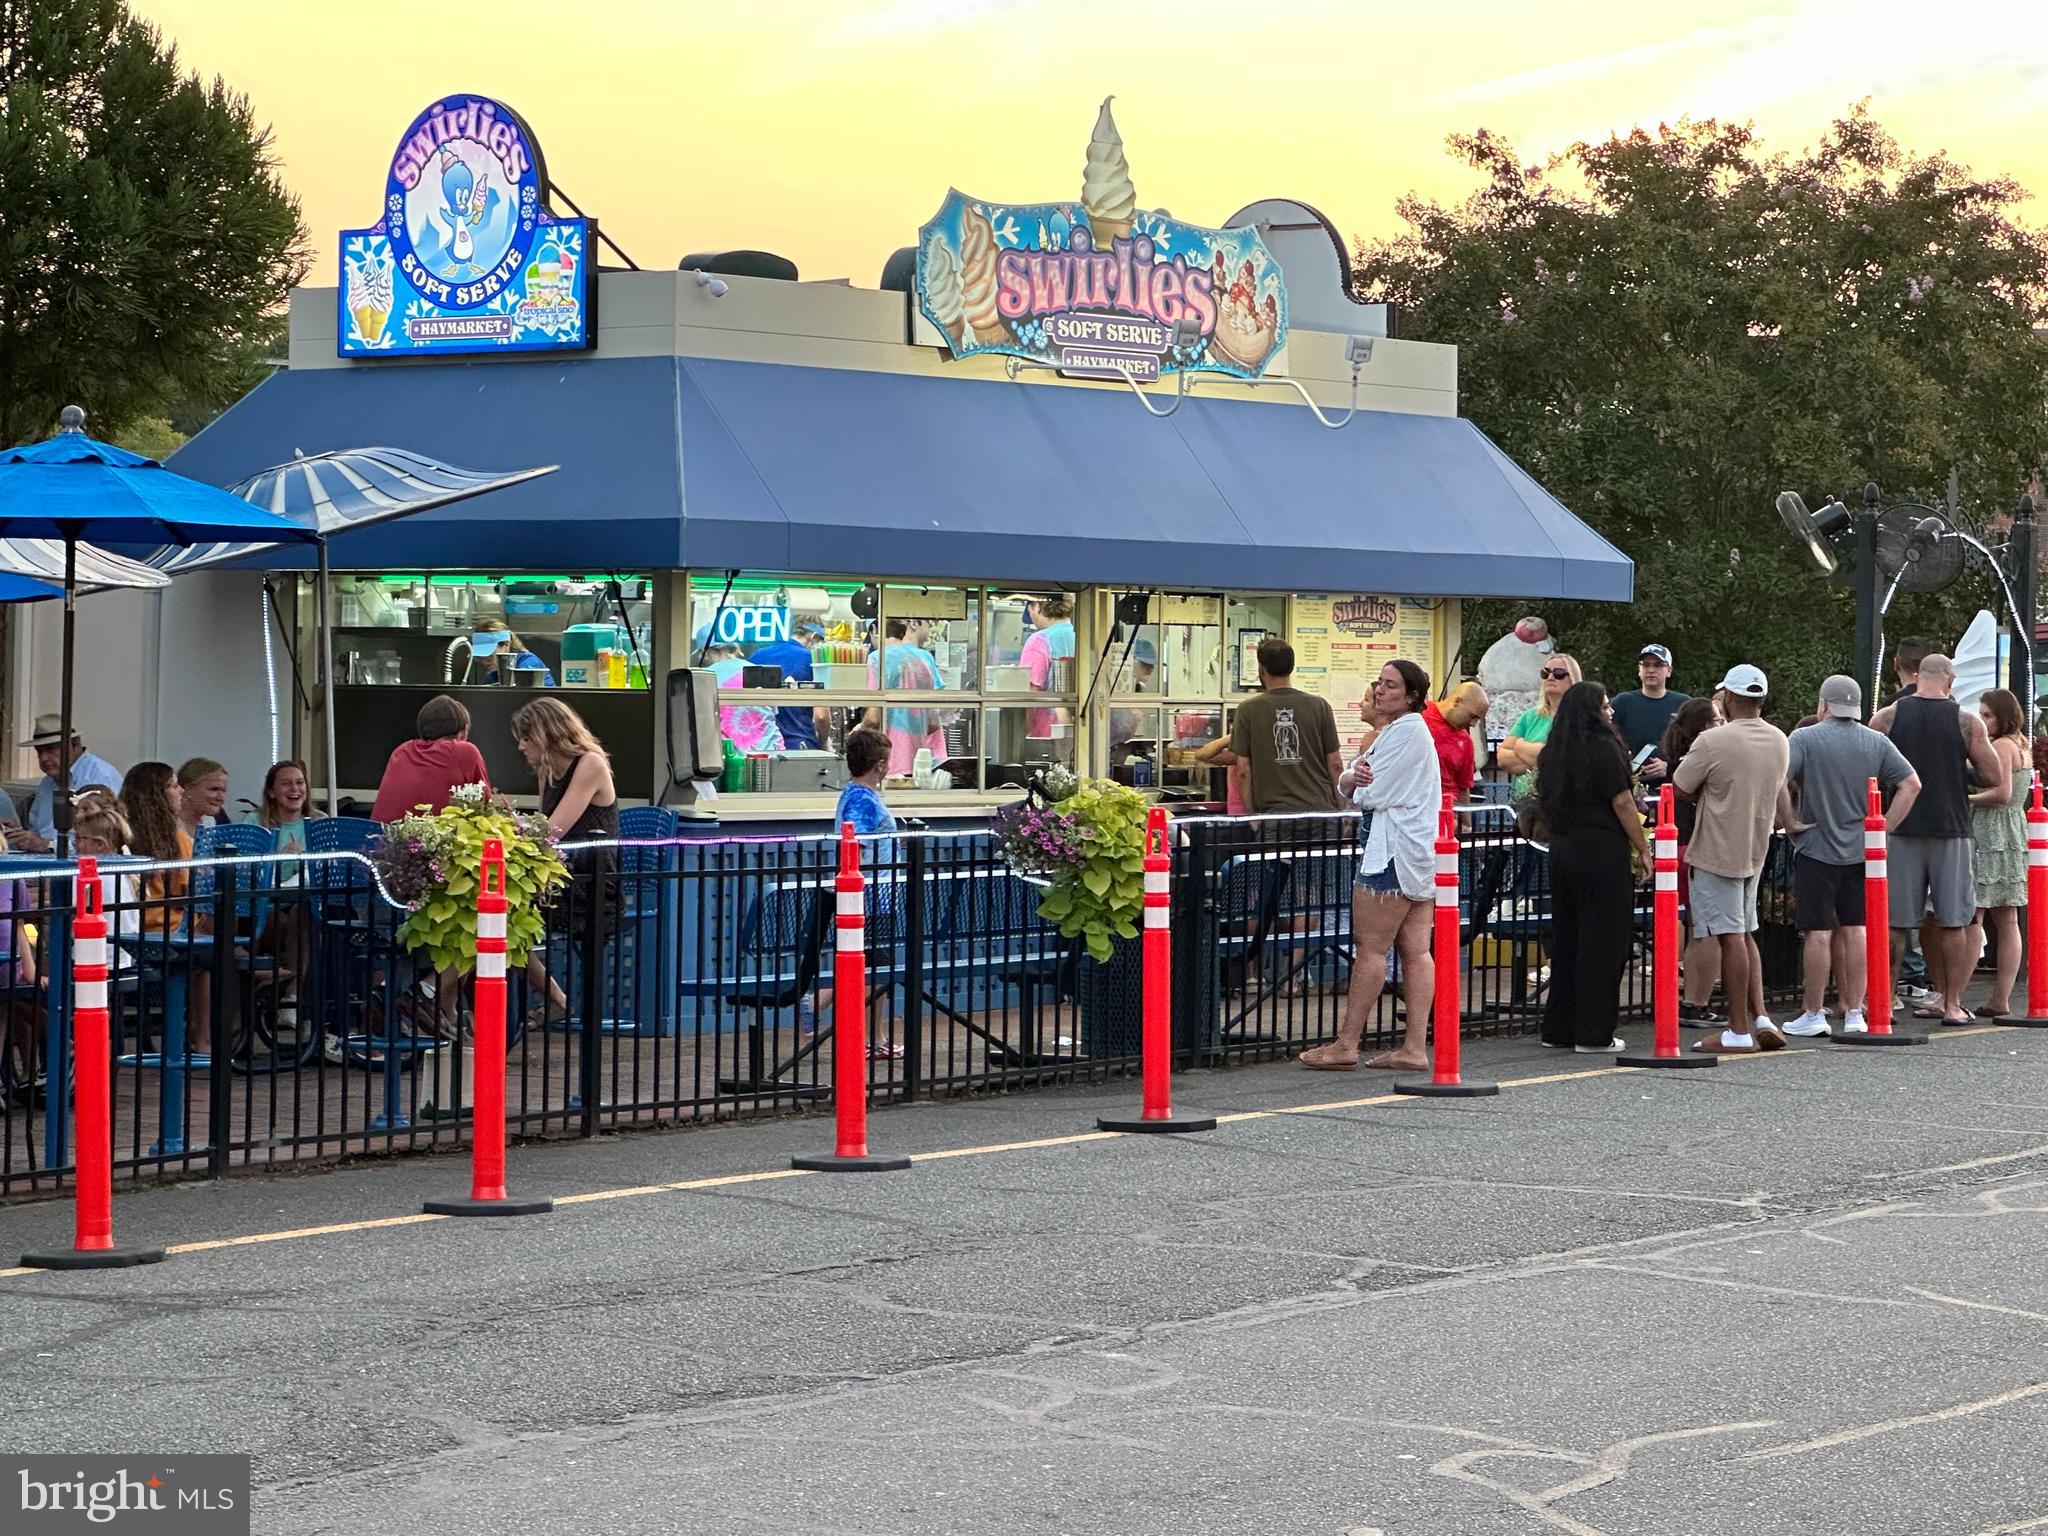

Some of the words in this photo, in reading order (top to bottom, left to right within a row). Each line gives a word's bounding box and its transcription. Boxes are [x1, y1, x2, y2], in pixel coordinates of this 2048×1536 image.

[401, 252, 452, 303] SOFT
[456, 247, 522, 305] SERVE
[523, 305, 557, 317] tropical
[558, 306, 574, 314] sno
[420, 320, 503, 336] HAYMARKET
[1057, 319, 1103, 340] SOFT
[1106, 323, 1163, 345] SERVE
[718, 607, 791, 643] OPEN
